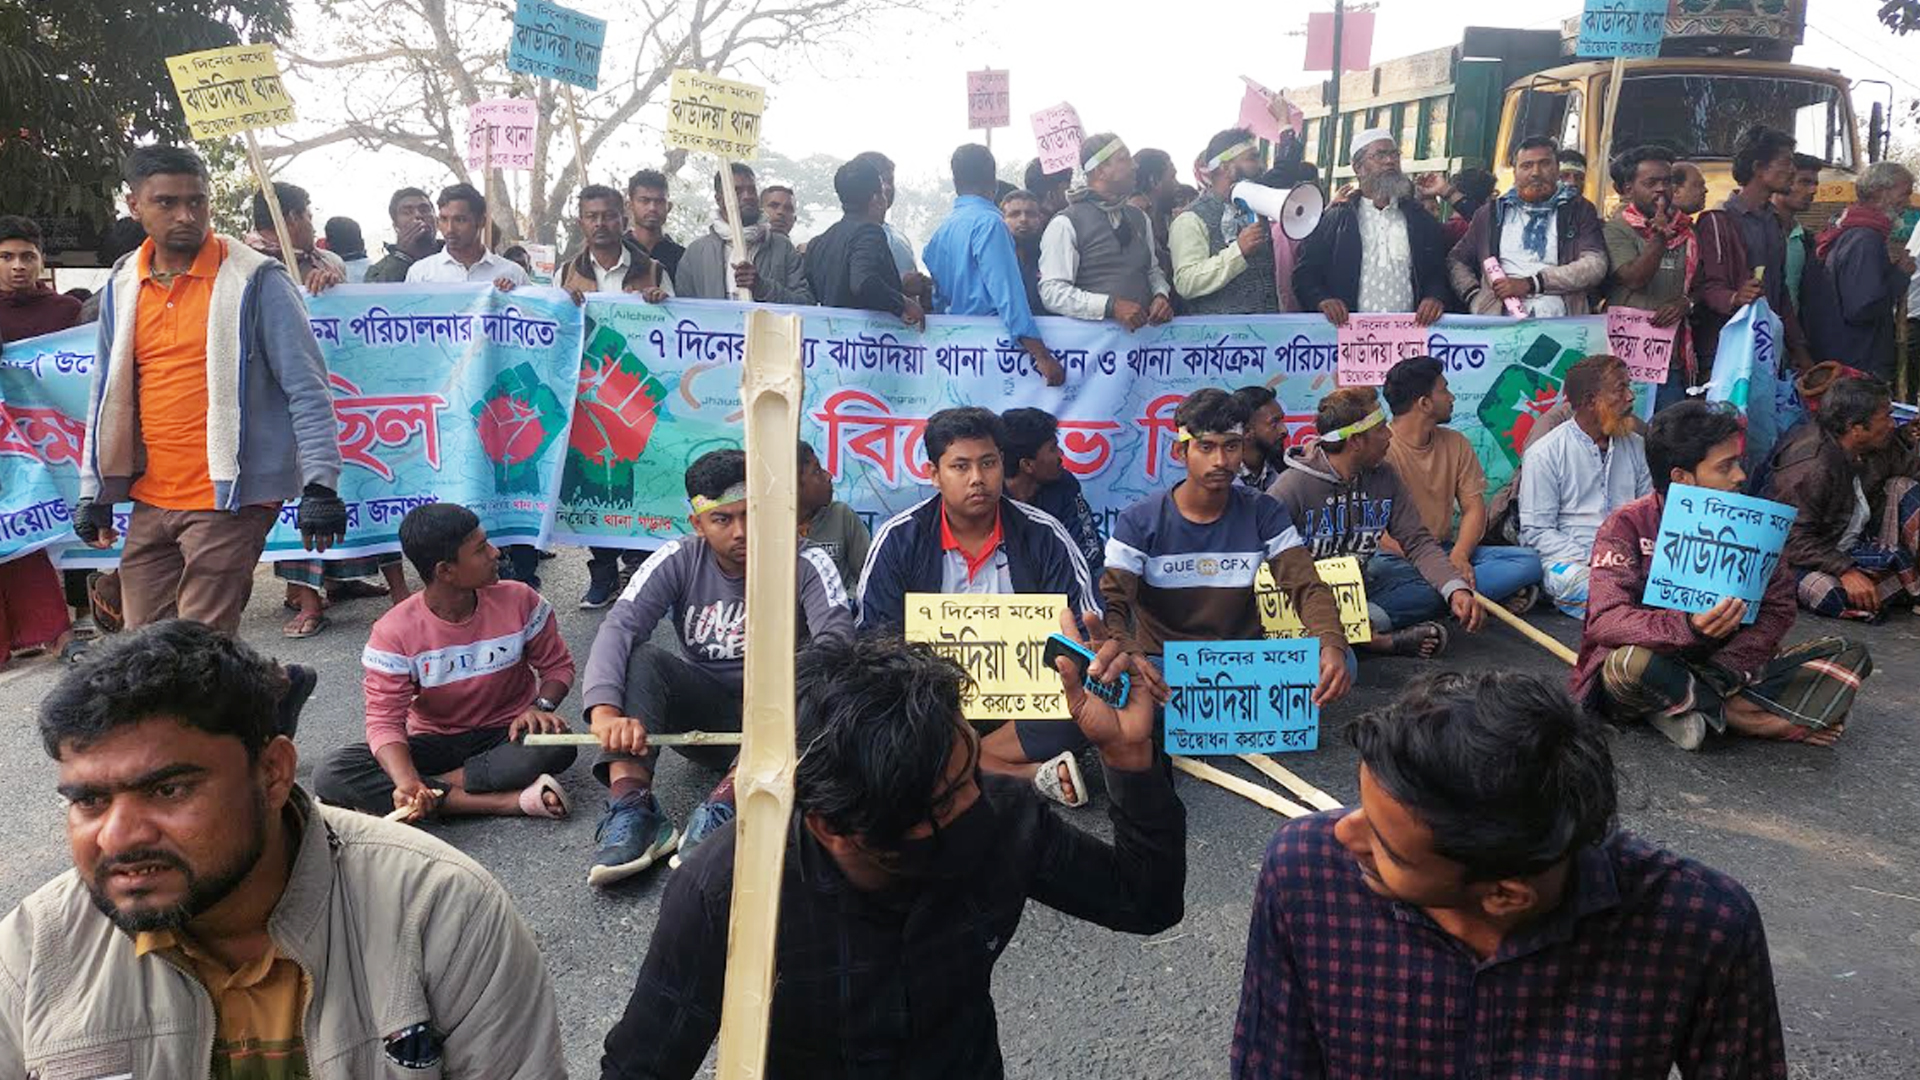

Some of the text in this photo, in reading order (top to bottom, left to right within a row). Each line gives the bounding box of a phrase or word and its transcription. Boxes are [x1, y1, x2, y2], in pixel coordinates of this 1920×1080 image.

[1585, 1, 1640, 35] ঝাউদিয়া
[516, 22, 603, 72] ঝাউদিয়া থানা
[192, 57, 234, 71] দিনের
[181, 73, 288, 113] ঝাউদিয়া থানা
[691, 77, 726, 94] দিনের
[672, 95, 760, 140] ঝাউদিয়া থানা
[505, 125, 533, 149] থানা
[350, 306, 473, 345] পরিচালনার
[480, 307, 558, 346] দাবিতে
[649, 329, 666, 358] ৭
[827, 331, 927, 376] ঝাউদিয়া
[936, 345, 987, 378] থানা
[1097, 349, 1117, 376] ও
[1127, 346, 1173, 377] থানা
[1182, 335, 1266, 375] কার্যক্রম
[1428, 332, 1489, 374] বিতে
[1341, 333, 1393, 367] ঝাউদিয়া
[1643, 336, 1671, 363] থানা
[604, 514, 632, 528] থানা
[1680, 498, 1694, 514] ৭
[1704, 497, 1765, 527] দিনের
[1163, 559, 1250, 574] GUE CFX
[1664, 521, 1761, 590] ঝাউদিয়া
[919, 600, 1055, 620] ৭ দিনের মধ্যে
[1176, 648, 1308, 668] ৭ দিনের মধ্যে
[981, 693, 1027, 713] করতে
[1170, 671, 1318, 724] ঝাউদিয়া থানা
[1234, 730, 1277, 748] করতে
